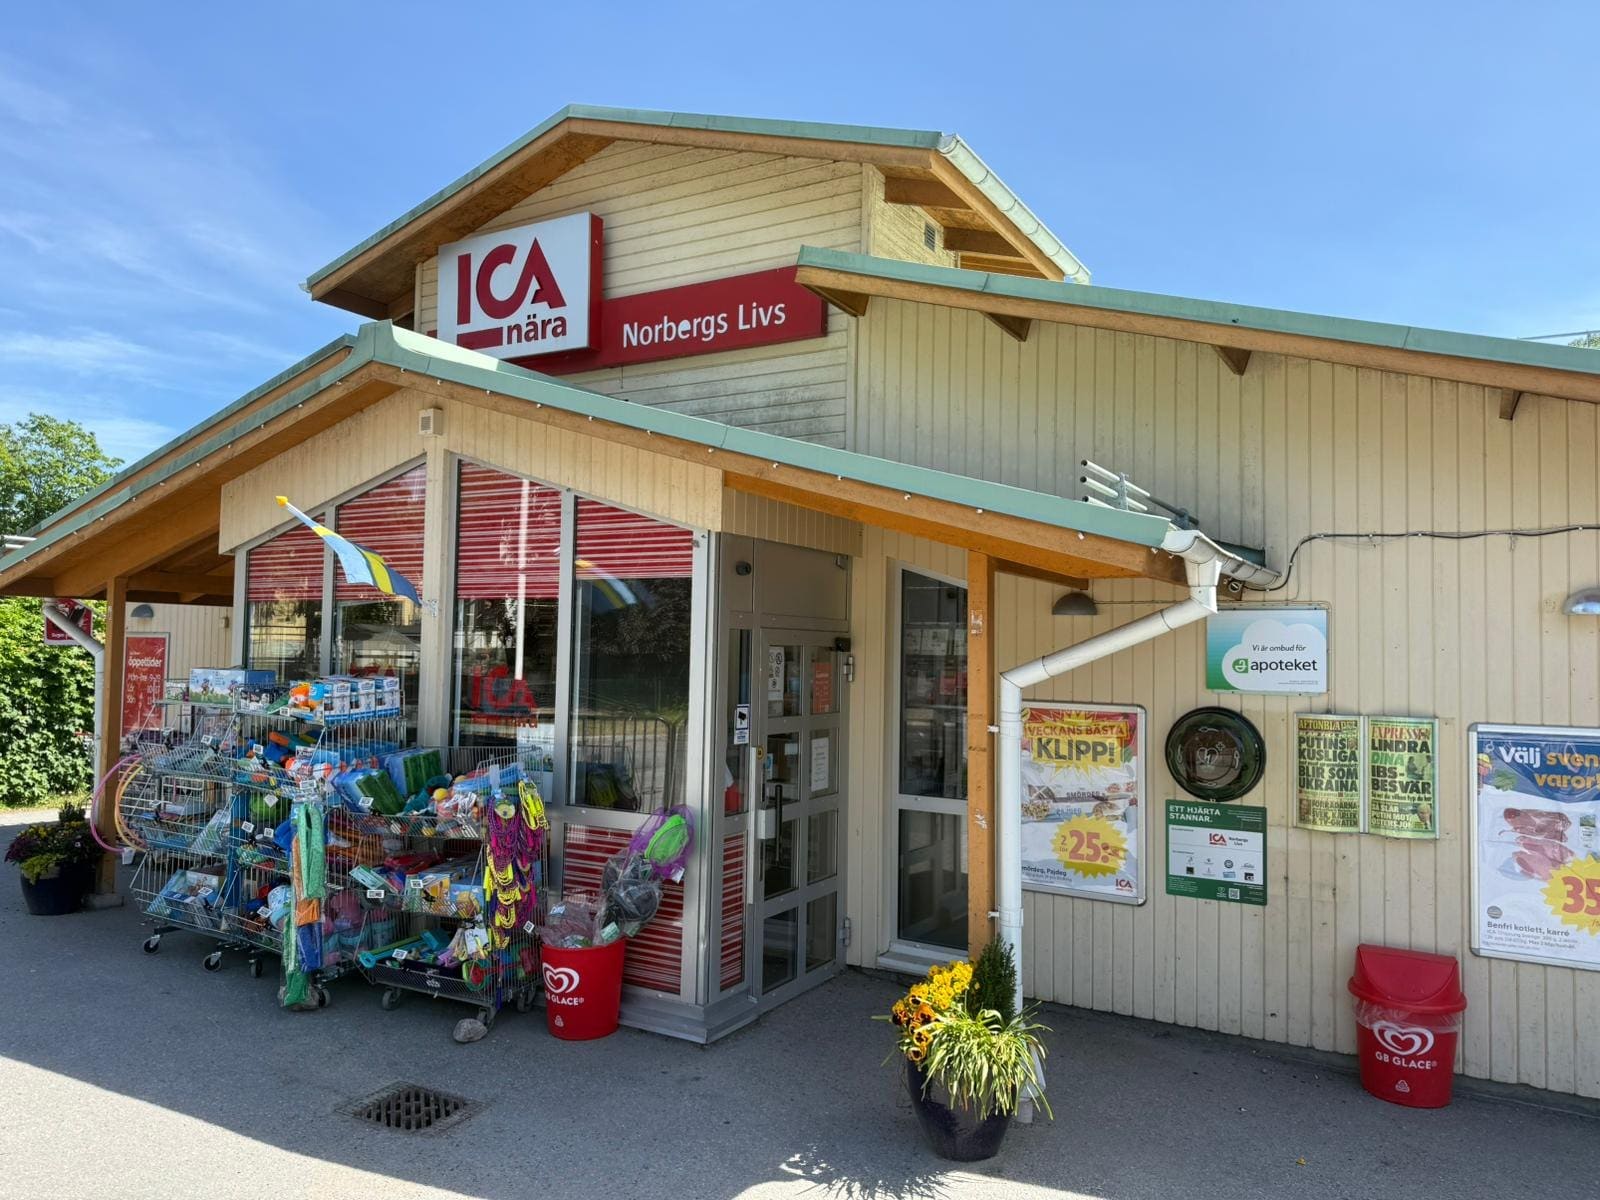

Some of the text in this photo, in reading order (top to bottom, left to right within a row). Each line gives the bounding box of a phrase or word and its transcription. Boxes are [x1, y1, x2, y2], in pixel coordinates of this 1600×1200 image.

[457, 237, 567, 326] ICA
[507, 314, 567, 345] nära
[623, 302, 786, 348] Norbergs Livs
[1252, 644, 1307, 652] Vi är ombud för
[1250, 658, 1318, 674] apoteket
[472, 663, 538, 710] ICA
[1027, 723, 1125, 737] VECKANS BÄSTA
[1036, 736, 1115, 764] KLIPP!
[1371, 739, 1431, 754] LINDRA
[1299, 748, 1358, 763] KUSLIGA
[1371, 752, 1405, 766] DINA
[1499, 746, 1600, 769] Välj sven
[1299, 765, 1358, 780] BLIR SOM
[1371, 765, 1405, 779] IBS-
[1299, 777, 1358, 792] UKRAINA
[1371, 778, 1432, 794] BESVÄR
[1169, 805, 1186, 813] ETT
[1187, 806, 1221, 816] HJÄRTA
[1169, 812, 1213, 823] STANNAR.
[1060, 834, 1068, 847] 2
[1208, 832, 1227, 843] ICA
[1021, 865, 1047, 875] mördeg,
[1115, 878, 1134, 889] ICA
[1487, 921, 1571, 937] Benfri kotlett, karré
[1375, 1051, 1389, 1063] GB
